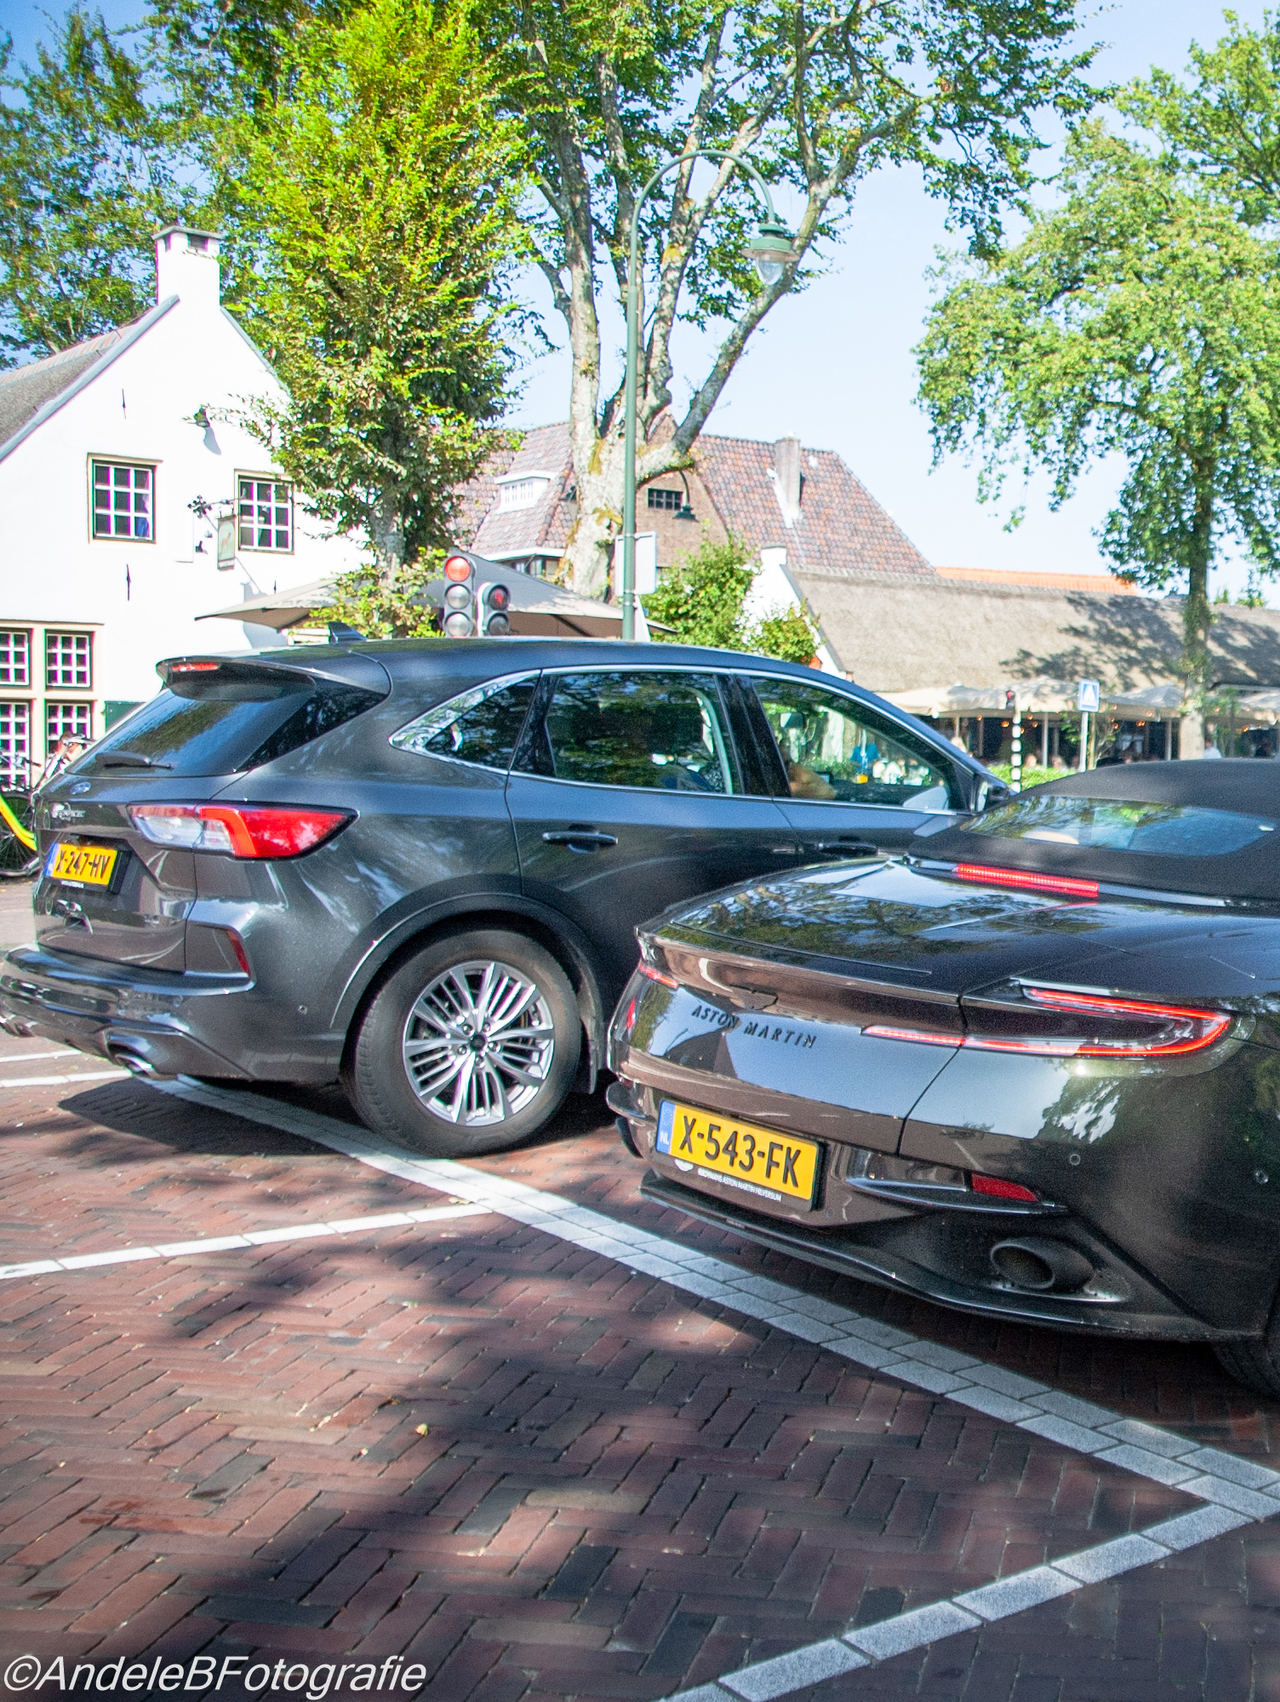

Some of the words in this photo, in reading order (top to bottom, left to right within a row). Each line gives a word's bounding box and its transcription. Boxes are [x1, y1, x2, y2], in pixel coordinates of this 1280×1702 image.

[56, 849, 111, 880] X-247-HV
[691, 1004, 741, 1029] ASTON
[742, 1021, 818, 1049] MARTIN
[659, 1131, 670, 1146] NL
[678, 1114, 802, 1189] X-543-FK
